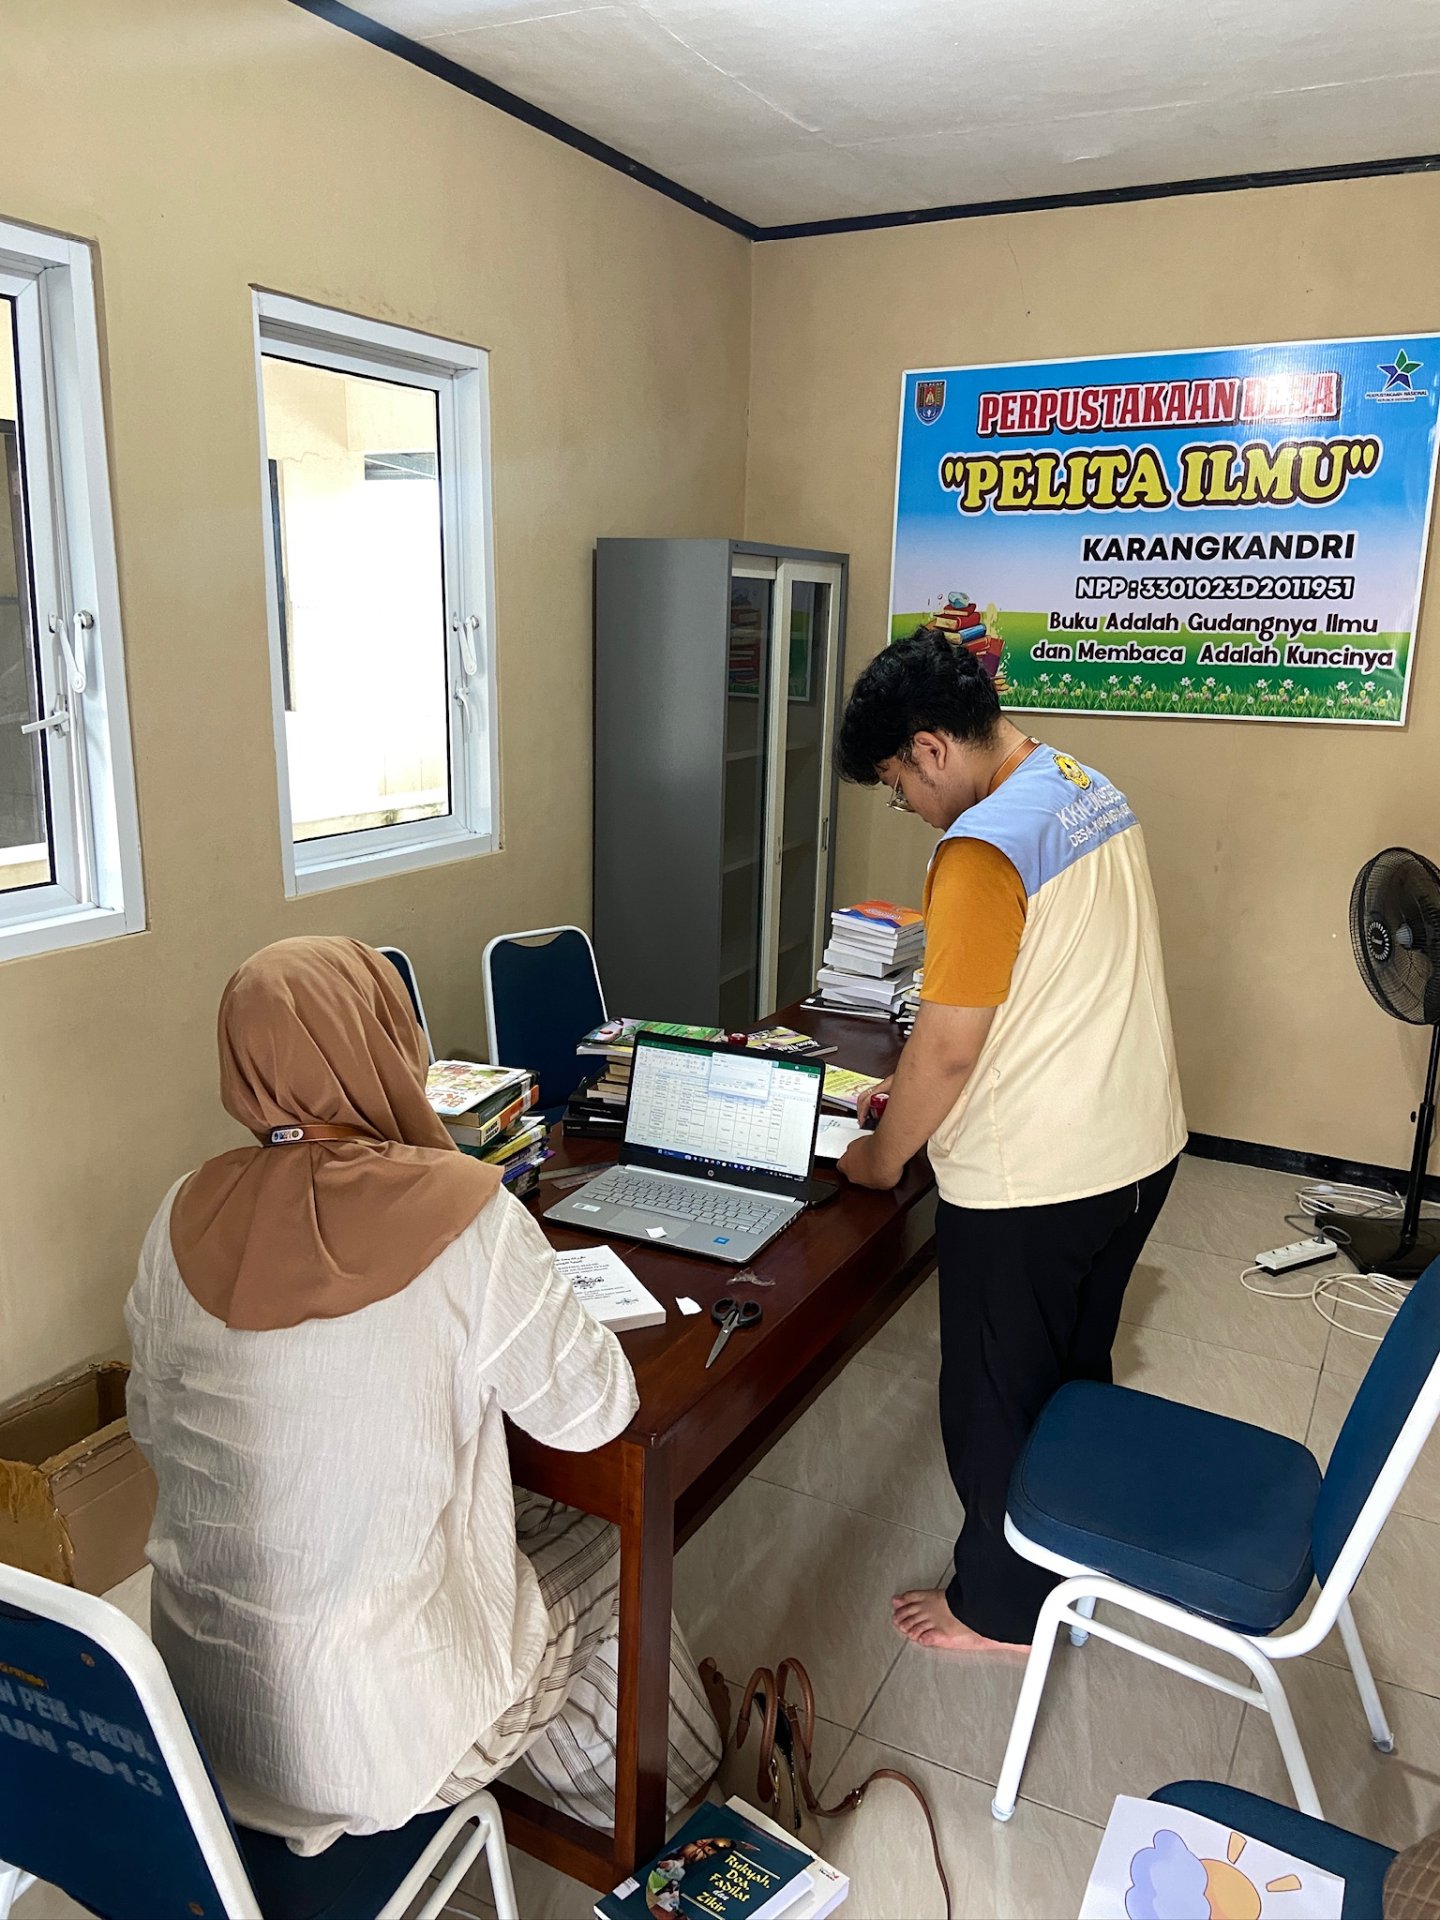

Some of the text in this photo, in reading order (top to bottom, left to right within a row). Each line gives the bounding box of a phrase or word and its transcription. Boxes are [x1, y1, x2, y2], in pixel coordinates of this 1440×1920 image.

[979, 380, 1236, 433] PERPUSTAKAAN
[1082, 533, 1356, 562] KARANGKANDRI
[1049, 611, 1379, 641] Buku Adalah Gudangnya Ilmu
[1032, 643, 1393, 670] dan Membaca Adalah Kuncinya
[1056, 799, 1092, 830] KKN
[1069, 826, 1094, 847] DESA
[66, 1740, 163, 1796] 2013
[724, 1854, 771, 1890] Rukyah,
[725, 1868, 750, 1891] Doa,
[696, 1891, 727, 1913] Zikir
[708, 1872, 750, 1903] Fadilat
